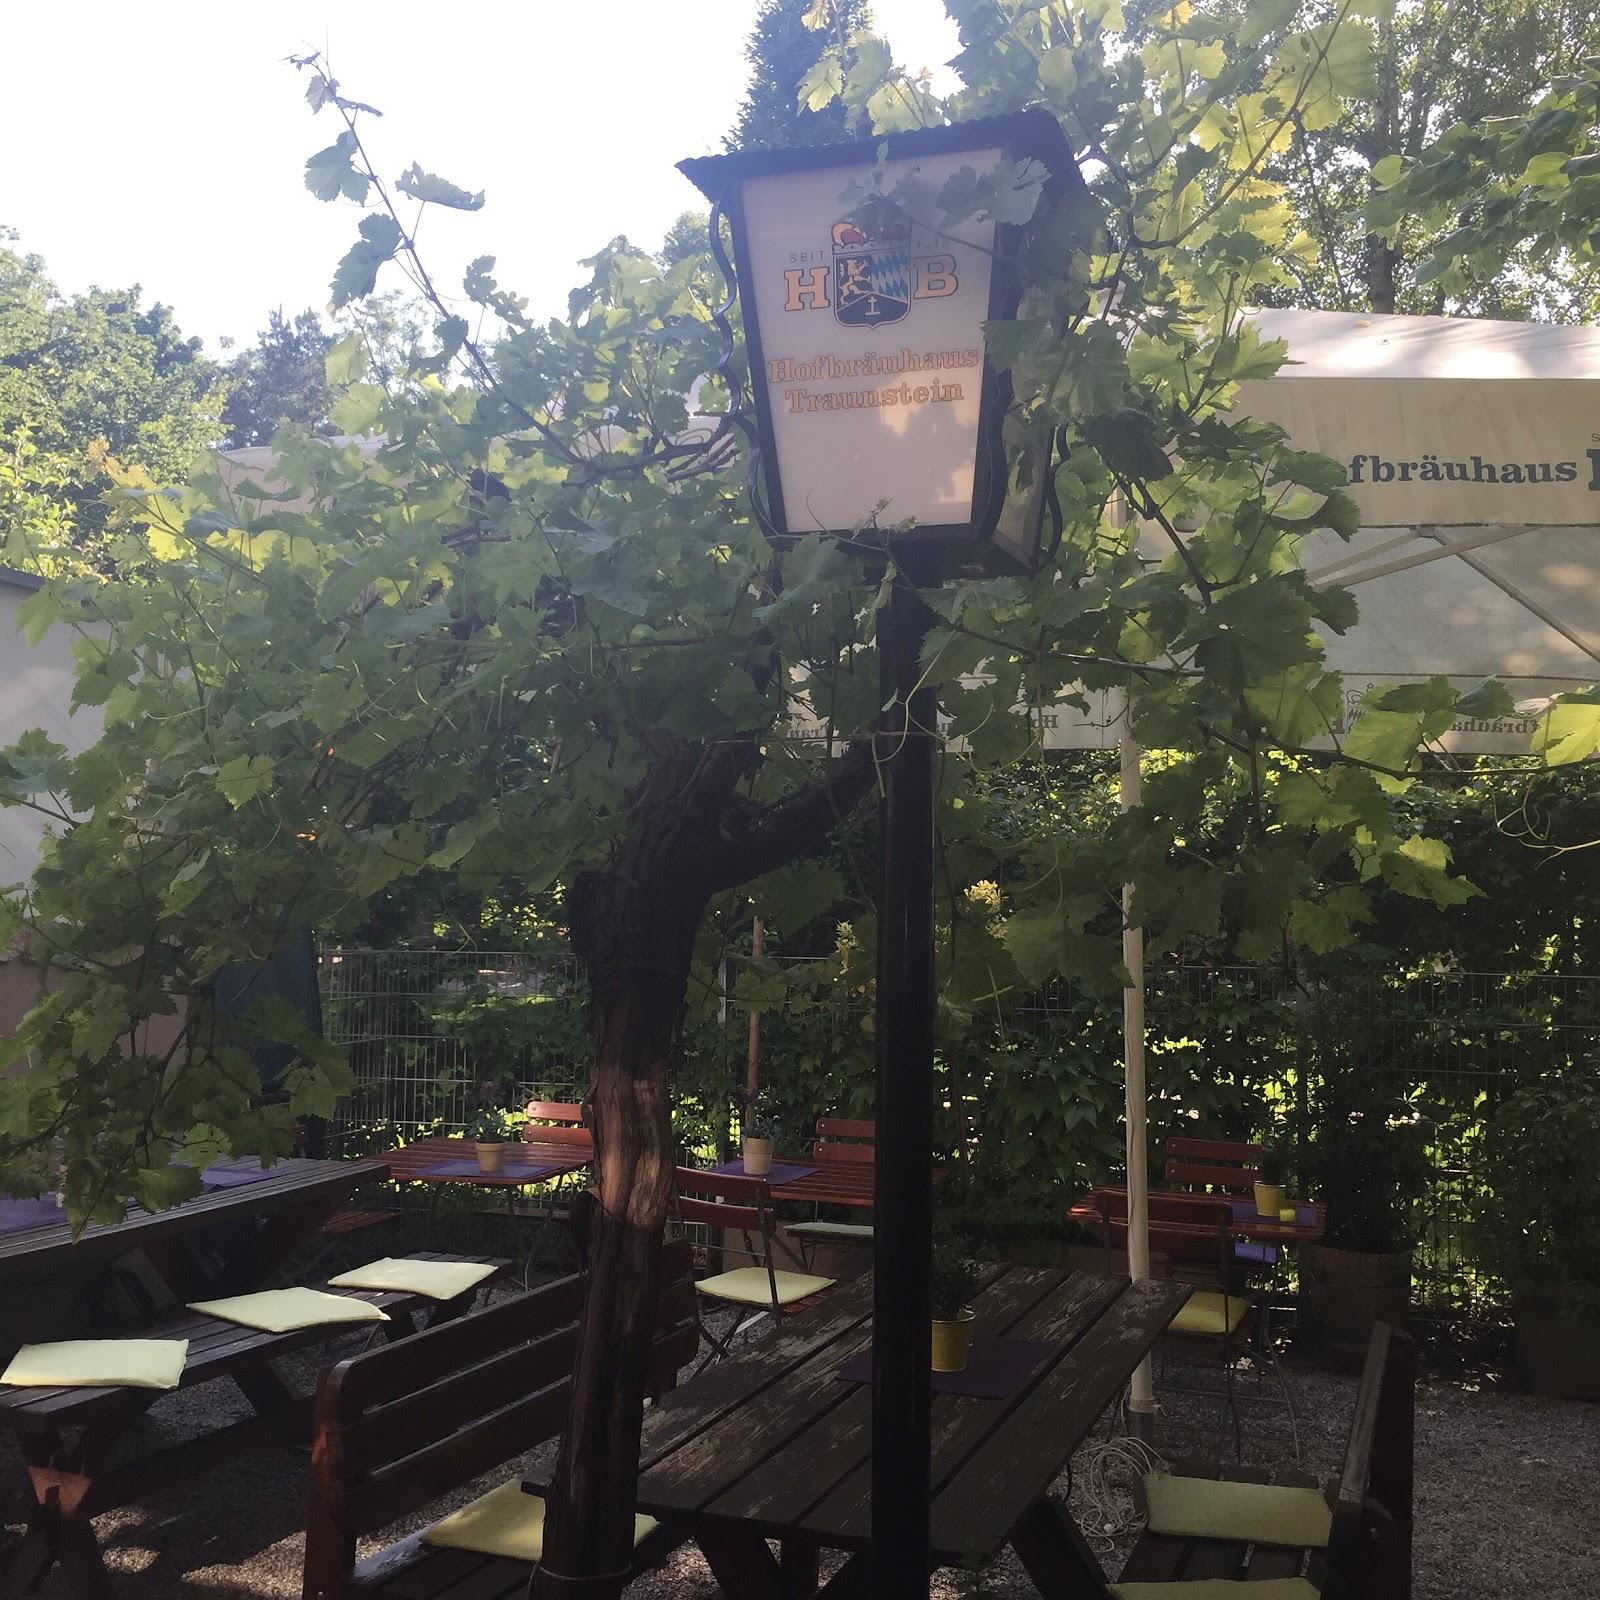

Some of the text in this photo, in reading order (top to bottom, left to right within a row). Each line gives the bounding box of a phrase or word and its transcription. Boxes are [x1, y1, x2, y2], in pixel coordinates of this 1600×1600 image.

[789, 250, 825, 263] SEIT
[784, 254, 959, 312] H B
[767, 349, 979, 384] Hofbräuhaus
[784, 378, 964, 414] Traunstein
[1347, 454, 1578, 484] fbräuhaus
